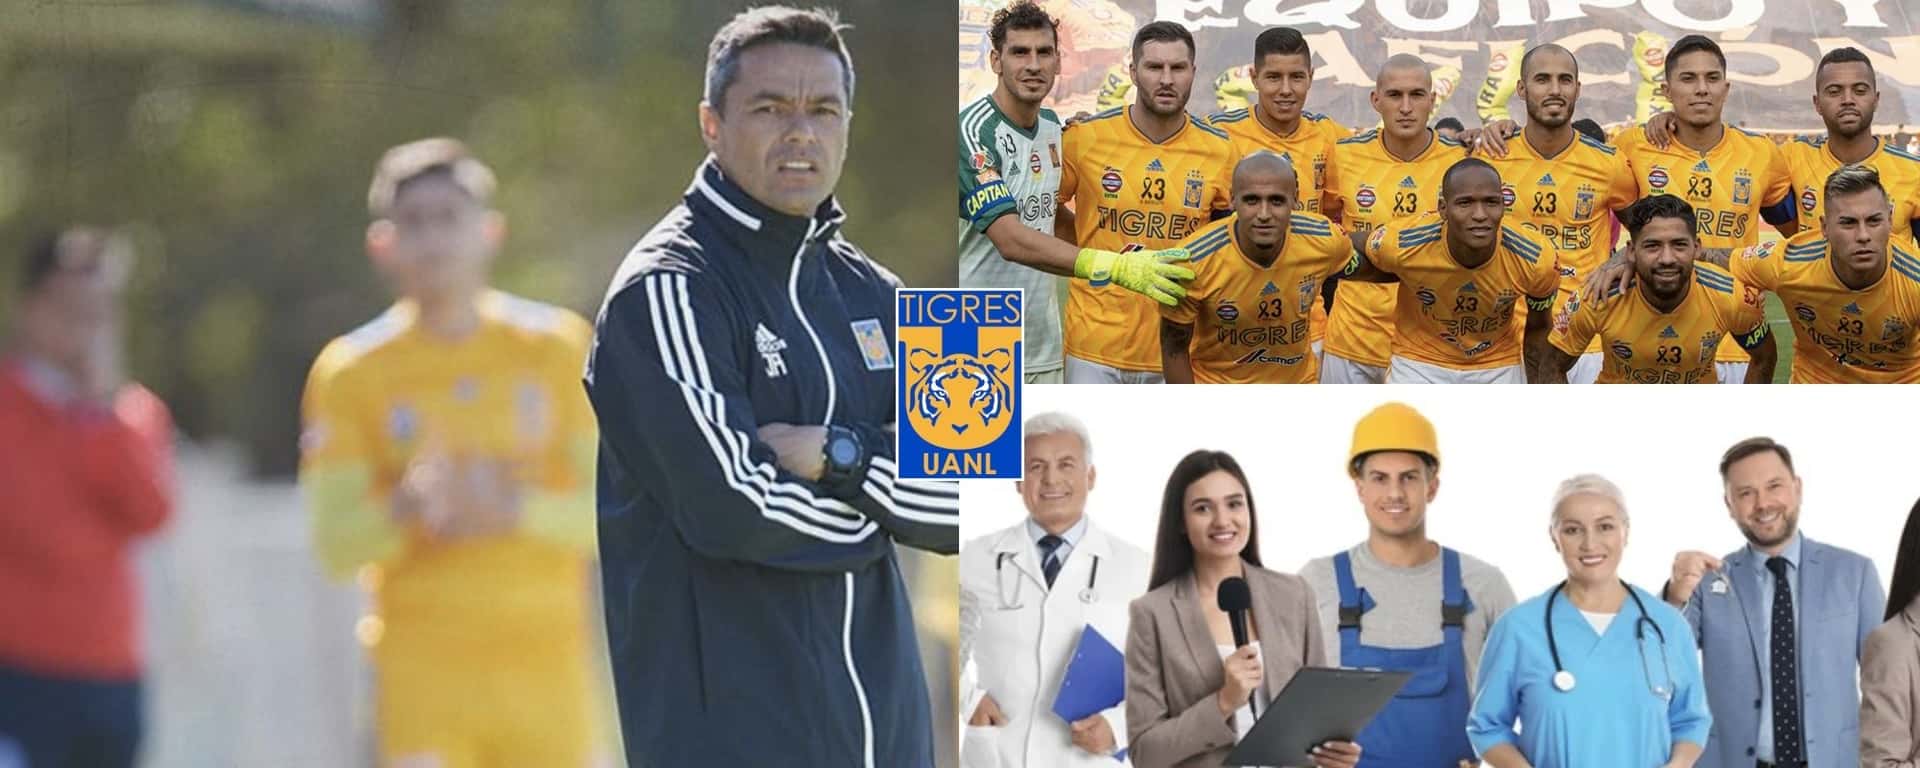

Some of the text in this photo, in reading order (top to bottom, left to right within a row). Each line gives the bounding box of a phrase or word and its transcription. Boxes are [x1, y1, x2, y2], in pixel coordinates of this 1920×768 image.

[1303, 27, 1920, 87] AFCÓN
[1097, 205, 1200, 240] TIGRES
[1520, 221, 1593, 250] RES
[1216, 319, 1310, 347] TIGRE
